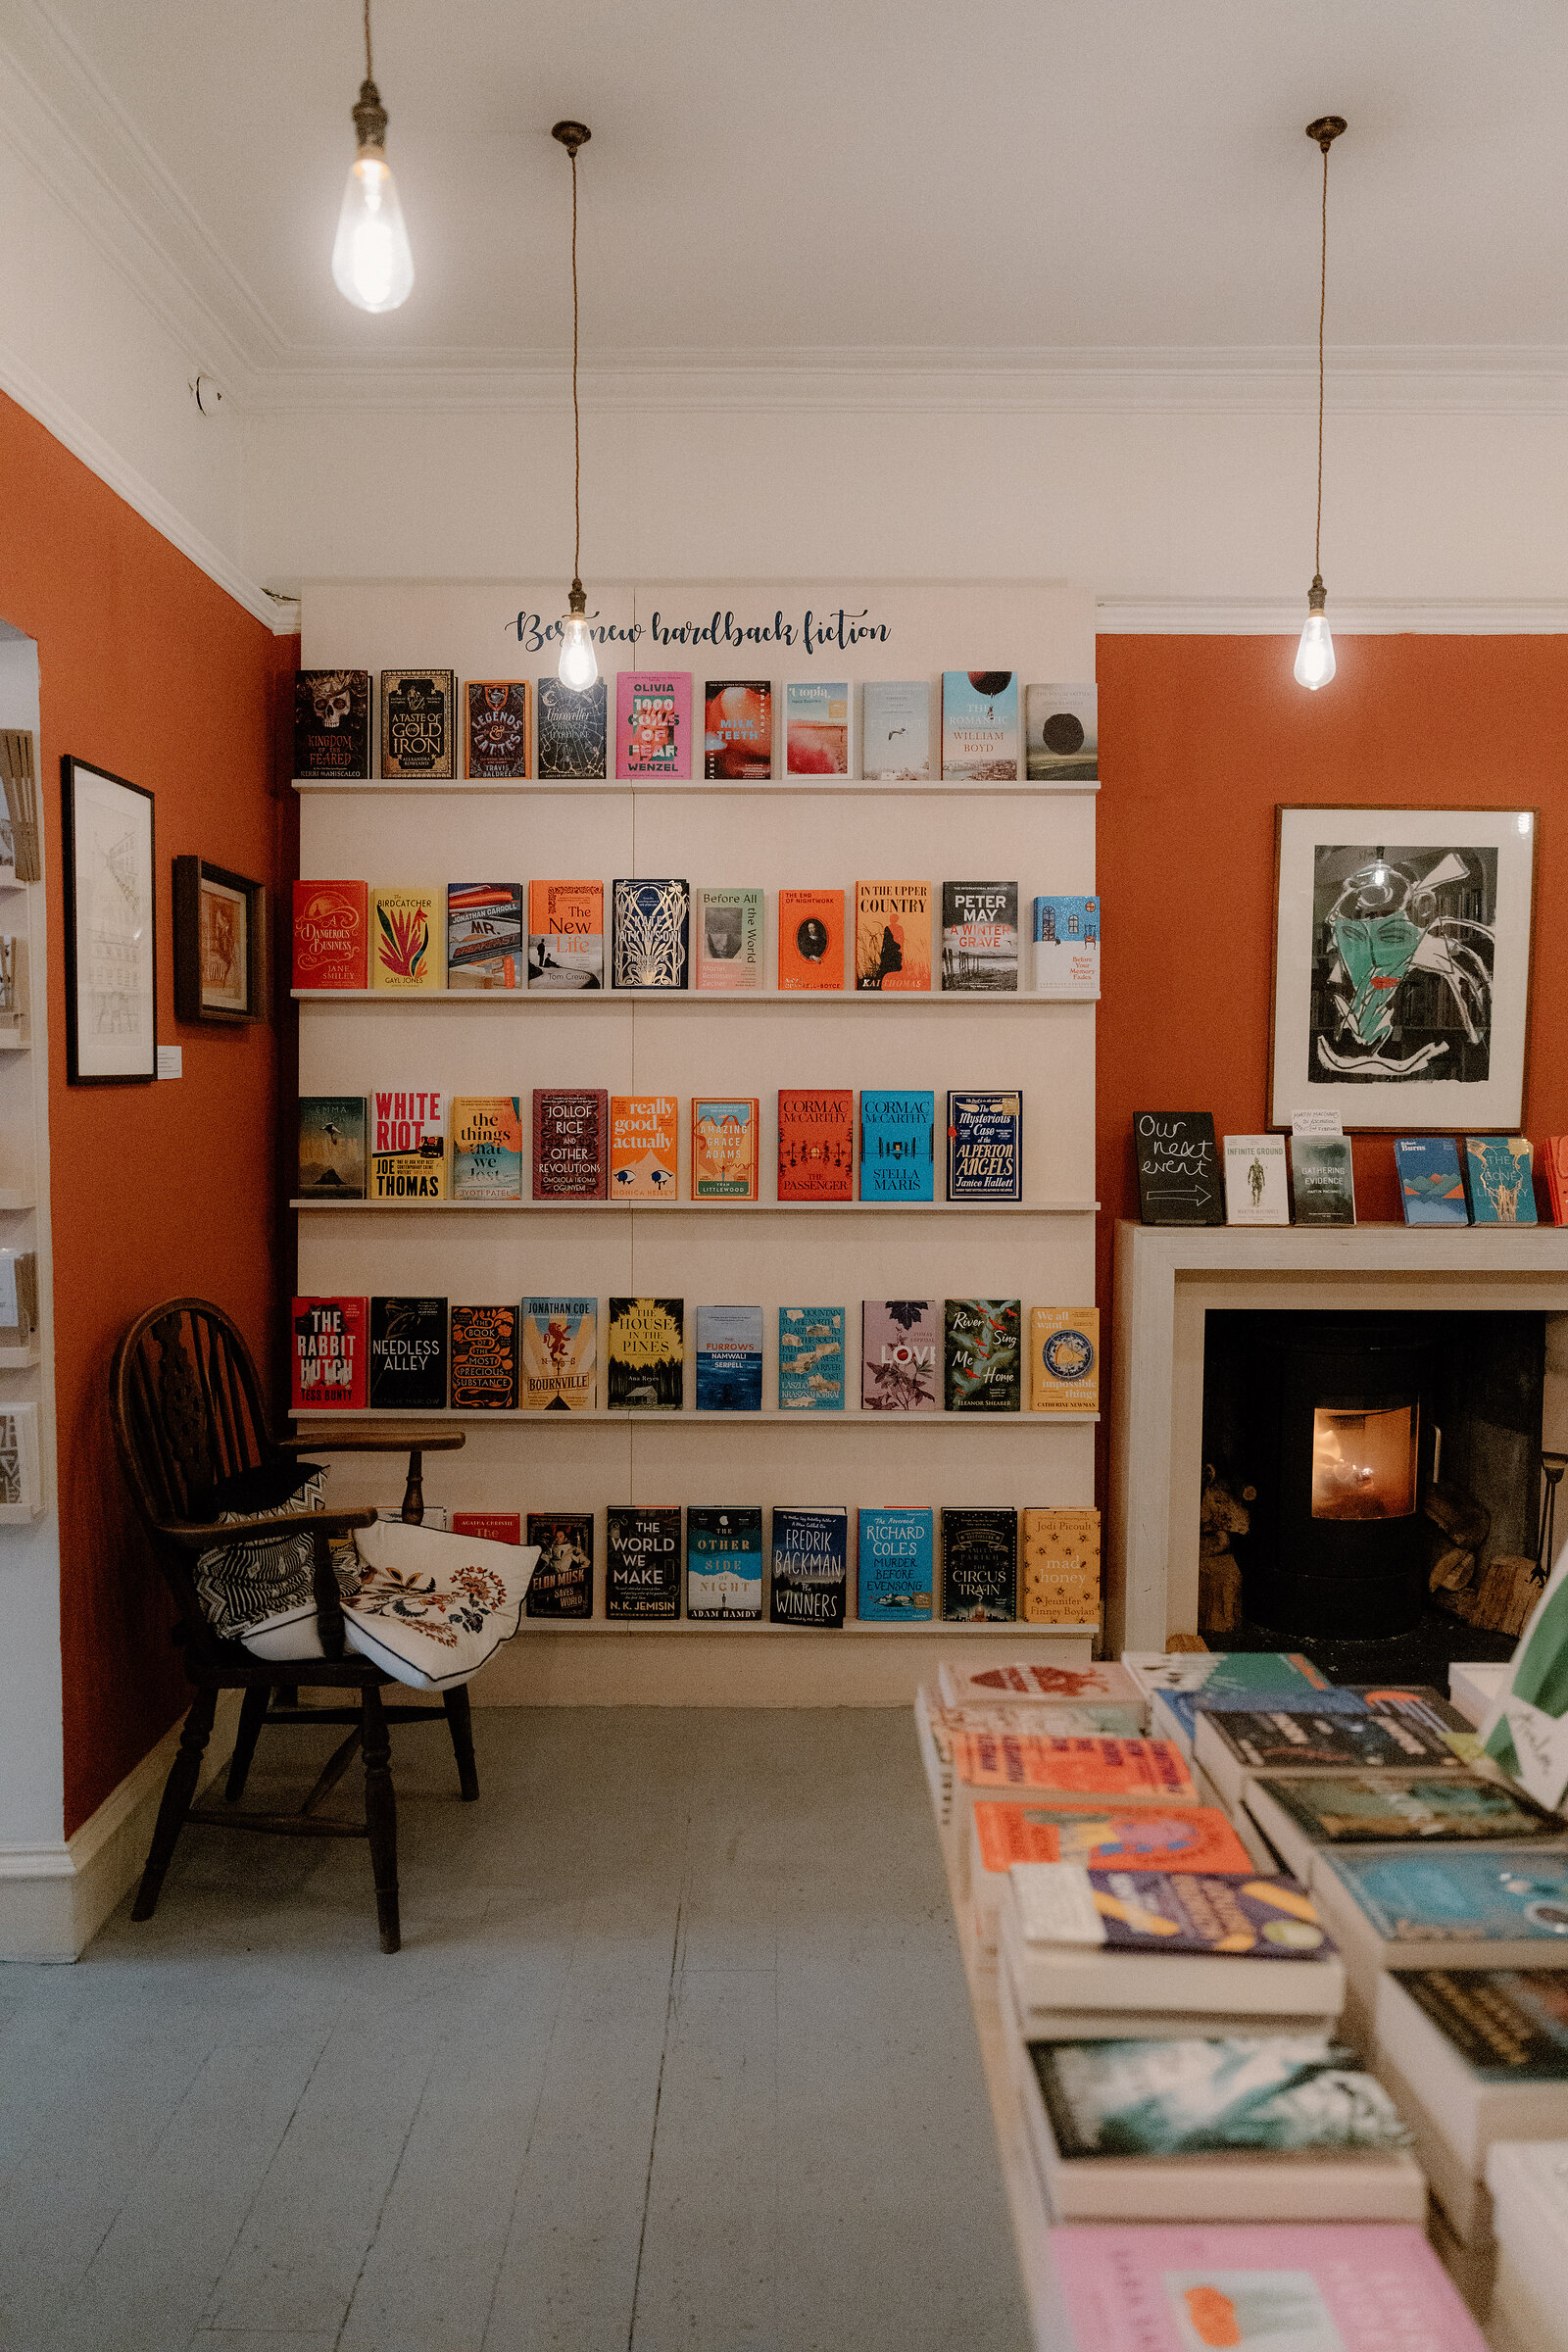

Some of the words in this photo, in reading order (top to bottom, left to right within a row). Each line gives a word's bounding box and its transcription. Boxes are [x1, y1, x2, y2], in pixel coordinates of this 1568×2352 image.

[590, 620, 647, 645] new
[652, 611, 799, 647] hardback
[803, 609, 892, 655] fiction
[399, 713, 426, 722] TASTE
[471, 711, 523, 730] LEGENDS
[628, 713, 680, 726] COILS
[720, 719, 754, 728] MILK
[949, 715, 1007, 725] ROMANTIC
[392, 722, 441, 737] GOLD
[716, 731, 759, 740] TEETH
[393, 738, 441, 754] IRON
[474, 733, 521, 756] LATTES
[629, 745, 678, 758] FEAR
[860, 886, 871, 896] IN
[872, 886, 893, 896] THE
[895, 886, 927, 896] UPPER
[704, 894, 740, 904] Before
[743, 894, 758, 904] All
[955, 895, 1006, 907] PETER
[568, 906, 591, 917] The
[860, 899, 927, 913] COUNTRY
[453, 910, 486, 923] JONATHAN
[487, 904, 517, 915] CARROLL
[963, 909, 998, 921] MAY
[549, 917, 591, 934] New
[635, 915, 663, 927] KATE
[301, 923, 351, 941] DANGEROUS
[470, 921, 501, 935] MR.
[951, 925, 958, 935] A
[962, 925, 1011, 936] WINTER
[310, 939, 352, 955] BUSINESS
[557, 936, 589, 954] Life
[959, 937, 1001, 948] GRAVE
[375, 1093, 441, 1121] WHITE
[549, 1105, 592, 1118] JOLLOF
[630, 1099, 674, 1118] really
[784, 1101, 849, 1113] CORMAC
[865, 1102, 929, 1114] CORMAC
[472, 1113, 498, 1126] the
[784, 1113, 849, 1123] McCARTHY
[865, 1114, 929, 1123] McCARTHY
[959, 1112, 1011, 1127] Mysterious
[556, 1121, 583, 1134] RICE
[614, 1115, 662, 1136] good,
[701, 1125, 748, 1134] AMAZING
[973, 1124, 995, 1136] Case
[1139, 1115, 1187, 1138] Our
[376, 1121, 425, 1151] RIOT
[461, 1127, 511, 1144] things
[612, 1133, 674, 1152] actually
[707, 1138, 741, 1147] GRACE
[551, 1149, 588, 1160] OTHER
[706, 1150, 742, 1159] ADAMS
[956, 1144, 1013, 1158] ALPERTON
[1153, 1140, 1213, 1161] next
[376, 1159, 395, 1174] JOE
[474, 1157, 497, 1168] we
[1487, 1155, 1510, 1165] THE
[539, 1164, 601, 1174] REVOLUTIONS
[956, 1158, 1014, 1176] ANGELS
[1142, 1159, 1208, 1177] event
[1301, 1166, 1346, 1175] GATHERING
[873, 1169, 919, 1179] STELLA
[1485, 1172, 1518, 1182] BONE
[376, 1176, 439, 1197] THOMAS
[784, 1181, 848, 1191] PASSENGER
[874, 1180, 921, 1191] MARIS
[984, 1177, 1013, 1187] Hallett
[528, 1302, 572, 1313] JONATHAN
[573, 1303, 590, 1314] COE
[312, 1311, 341, 1333] THE
[619, 1318, 673, 1330] HOUSE
[953, 1311, 985, 1330] River
[1037, 1321, 1062, 1330] want
[643, 1331, 663, 1340] THE
[993, 1330, 1017, 1348] Sing
[298, 1335, 356, 1356] RABBIT
[372, 1340, 440, 1355] NEEDLESS
[623, 1341, 669, 1352] PINES
[384, 1356, 428, 1371] ALLEY
[952, 1350, 973, 1368] Me
[983, 1366, 1014, 1384] Home
[529, 1376, 587, 1391] BOURNVILLE
[1042, 1380, 1098, 1391] impossible
[302, 1390, 321, 1401] TESS
[324, 1390, 353, 1401] GUNTY
[1065, 1390, 1098, 1399] things
[636, 1522, 661, 1533] THE
[1037, 1522, 1056, 1532] Jodi
[1059, 1522, 1092, 1531] Picoult
[786, 1529, 833, 1552] FREDRIK
[866, 1526, 925, 1543] RICHARD
[612, 1538, 675, 1551] WORLD
[698, 1540, 750, 1550] OTHER
[873, 1542, 917, 1556] COLES
[623, 1555, 646, 1567] WE
[705, 1560, 742, 1571] SIDE
[775, 1549, 841, 1577] BACKMAN
[874, 1558, 917, 1568] MURDER
[1047, 1555, 1080, 1569] mad
[613, 1570, 663, 1585] MAKE
[875, 1569, 915, 1580] BEFORE
[953, 1570, 1006, 1583] CIRCUS
[1040, 1569, 1087, 1589] honey
[700, 1583, 750, 1592] NIGHT
[867, 1581, 923, 1592] EVENSONG
[610, 1601, 621, 1610] N.
[622, 1601, 632, 1610] K.
[634, 1601, 675, 1610] JEMISIN
[776, 1590, 838, 1617] WINNERS
